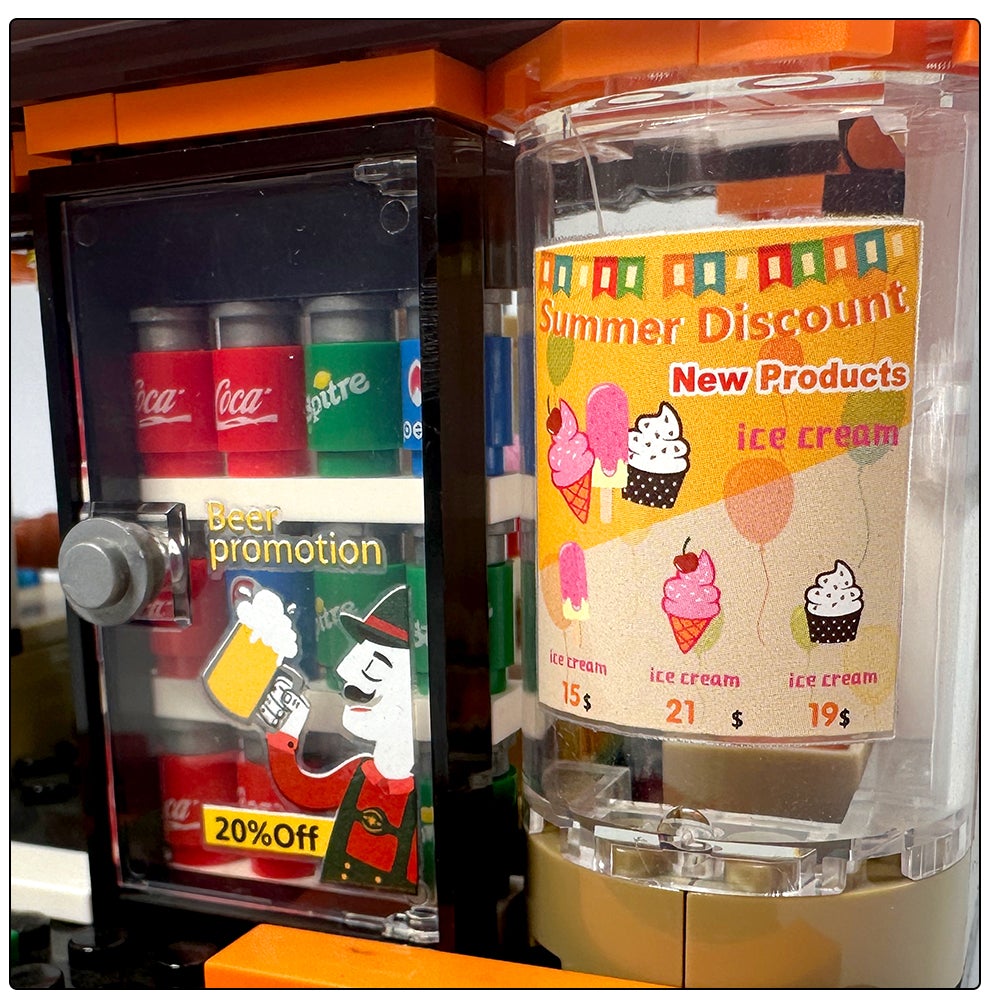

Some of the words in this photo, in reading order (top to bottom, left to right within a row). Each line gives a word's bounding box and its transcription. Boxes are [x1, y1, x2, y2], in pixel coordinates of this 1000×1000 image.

[540, 299, 684, 345] Summer
[700, 280, 909, 344] Discount
[672, 366, 749, 392] New
[761, 362, 907, 391] Products
[738, 422, 787, 450] ice
[798, 423, 900, 449] cream
[207, 500, 280, 532] Beer
[208, 532, 383, 571] promotion
[550, 650, 564, 666] ice
[567, 656, 607, 676] cream
[650, 667, 675, 684] ice
[680, 671, 740, 688] cream
[789, 672, 816, 689] ice
[821, 671, 878, 687] cream
[666, 698, 695, 725] 21
[215, 815, 320, 852] 20%Off
